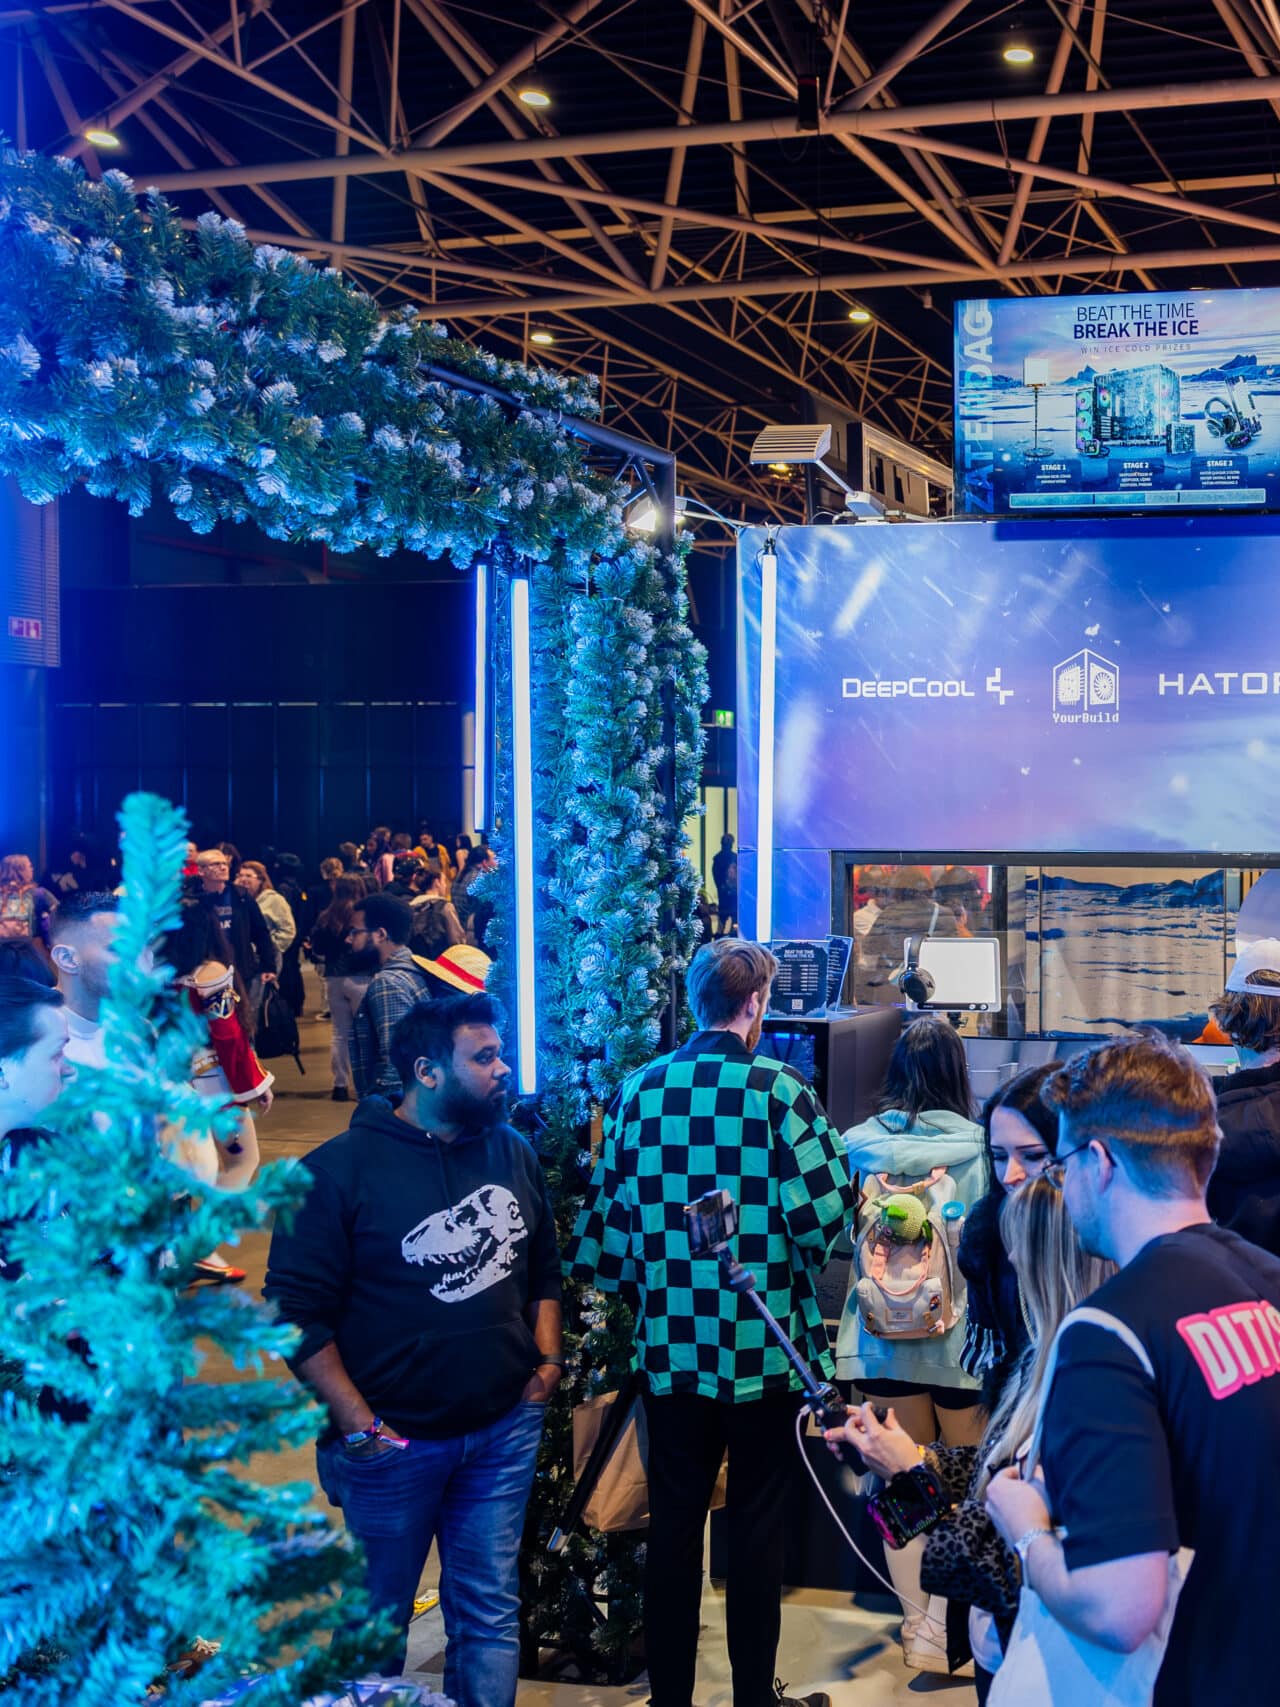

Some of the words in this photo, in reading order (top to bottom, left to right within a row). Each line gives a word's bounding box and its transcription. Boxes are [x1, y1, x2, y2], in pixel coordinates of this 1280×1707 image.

[1077, 306, 1116, 321] BEAT
[1120, 304, 1152, 320] THE
[1156, 302, 1195, 318] TIME
[1073, 322, 1130, 339] BREAK
[1133, 321, 1168, 337] THE
[1172, 320, 1199, 335] ICE
[1080, 346, 1099, 354] WIN
[1104, 345, 1120, 353] ICE
[1125, 344, 1150, 352] COLD
[1156, 343, 1191, 351] PRIZES
[1052, 712, 1120, 724] YourBuild
